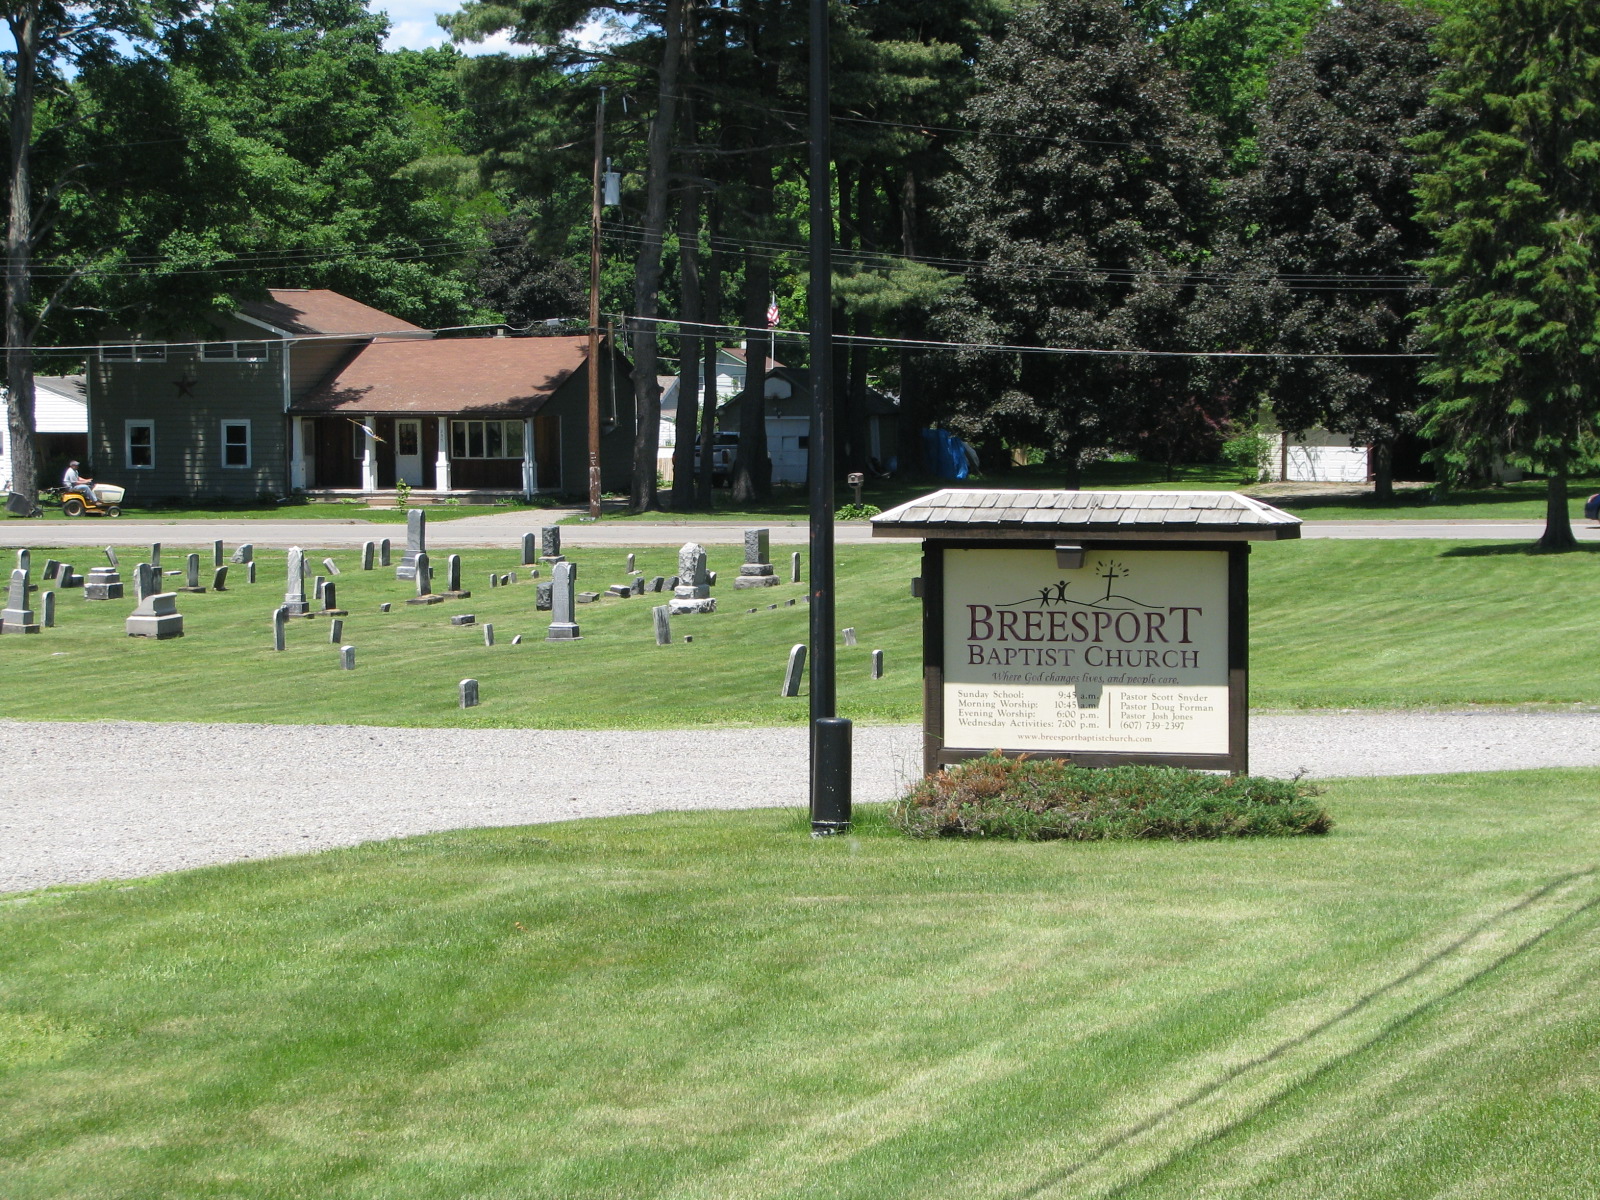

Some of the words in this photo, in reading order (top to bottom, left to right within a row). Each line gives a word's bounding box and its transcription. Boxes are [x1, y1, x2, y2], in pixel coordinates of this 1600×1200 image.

[966, 604, 1202, 644] BREESPORT
[967, 644, 1075, 667] BAPTIST
[1084, 645, 1200, 668] CHURCH
[992, 671, 1021, 682] Where
[1025, 672, 1043, 684] God
[1045, 672, 1080, 685] changes
[1082, 673, 1104, 684] lives,
[1107, 673, 1125, 684] and
[1127, 673, 1156, 685] people
[1159, 676, 1179, 685] care.
[957, 689, 989, 699] Sunday
[993, 690, 1024, 699] School:
[1058, 691, 1077, 699] 9:45
[1120, 692, 1147, 701] Pastor
[1151, 692, 1174, 701] Scott
[1178, 692, 1208, 703] Snyder
[958, 699, 996, 709] Morning
[1000, 700, 1038, 710] Worship:
[1054, 700, 1077, 709] 10:45
[1120, 701, 1147, 711] Pastor
[1151, 702, 1175, 712] Doug
[1179, 702, 1214, 712] Forman
[958, 709, 993, 718] Evening
[997, 709, 1036, 719] Worship:
[1056, 710, 1077, 718] 6:00
[1080, 712, 1100, 720] p.m.
[1120, 711, 1146, 720] Pastor
[1152, 711, 1169, 721] Josh
[1171, 712, 1194, 722] Jones
[958, 718, 1006, 728] Wednesday
[1010, 719, 1054, 728] Activities:
[1057, 719, 1077, 728] 7:00
[1080, 722, 1100, 730] p.m.
[1120, 721, 1142, 730] (607)
[1145, 721, 1185, 731] 739-2397
[1017, 732, 1153, 743] www.breesportbaptistchurch.com
